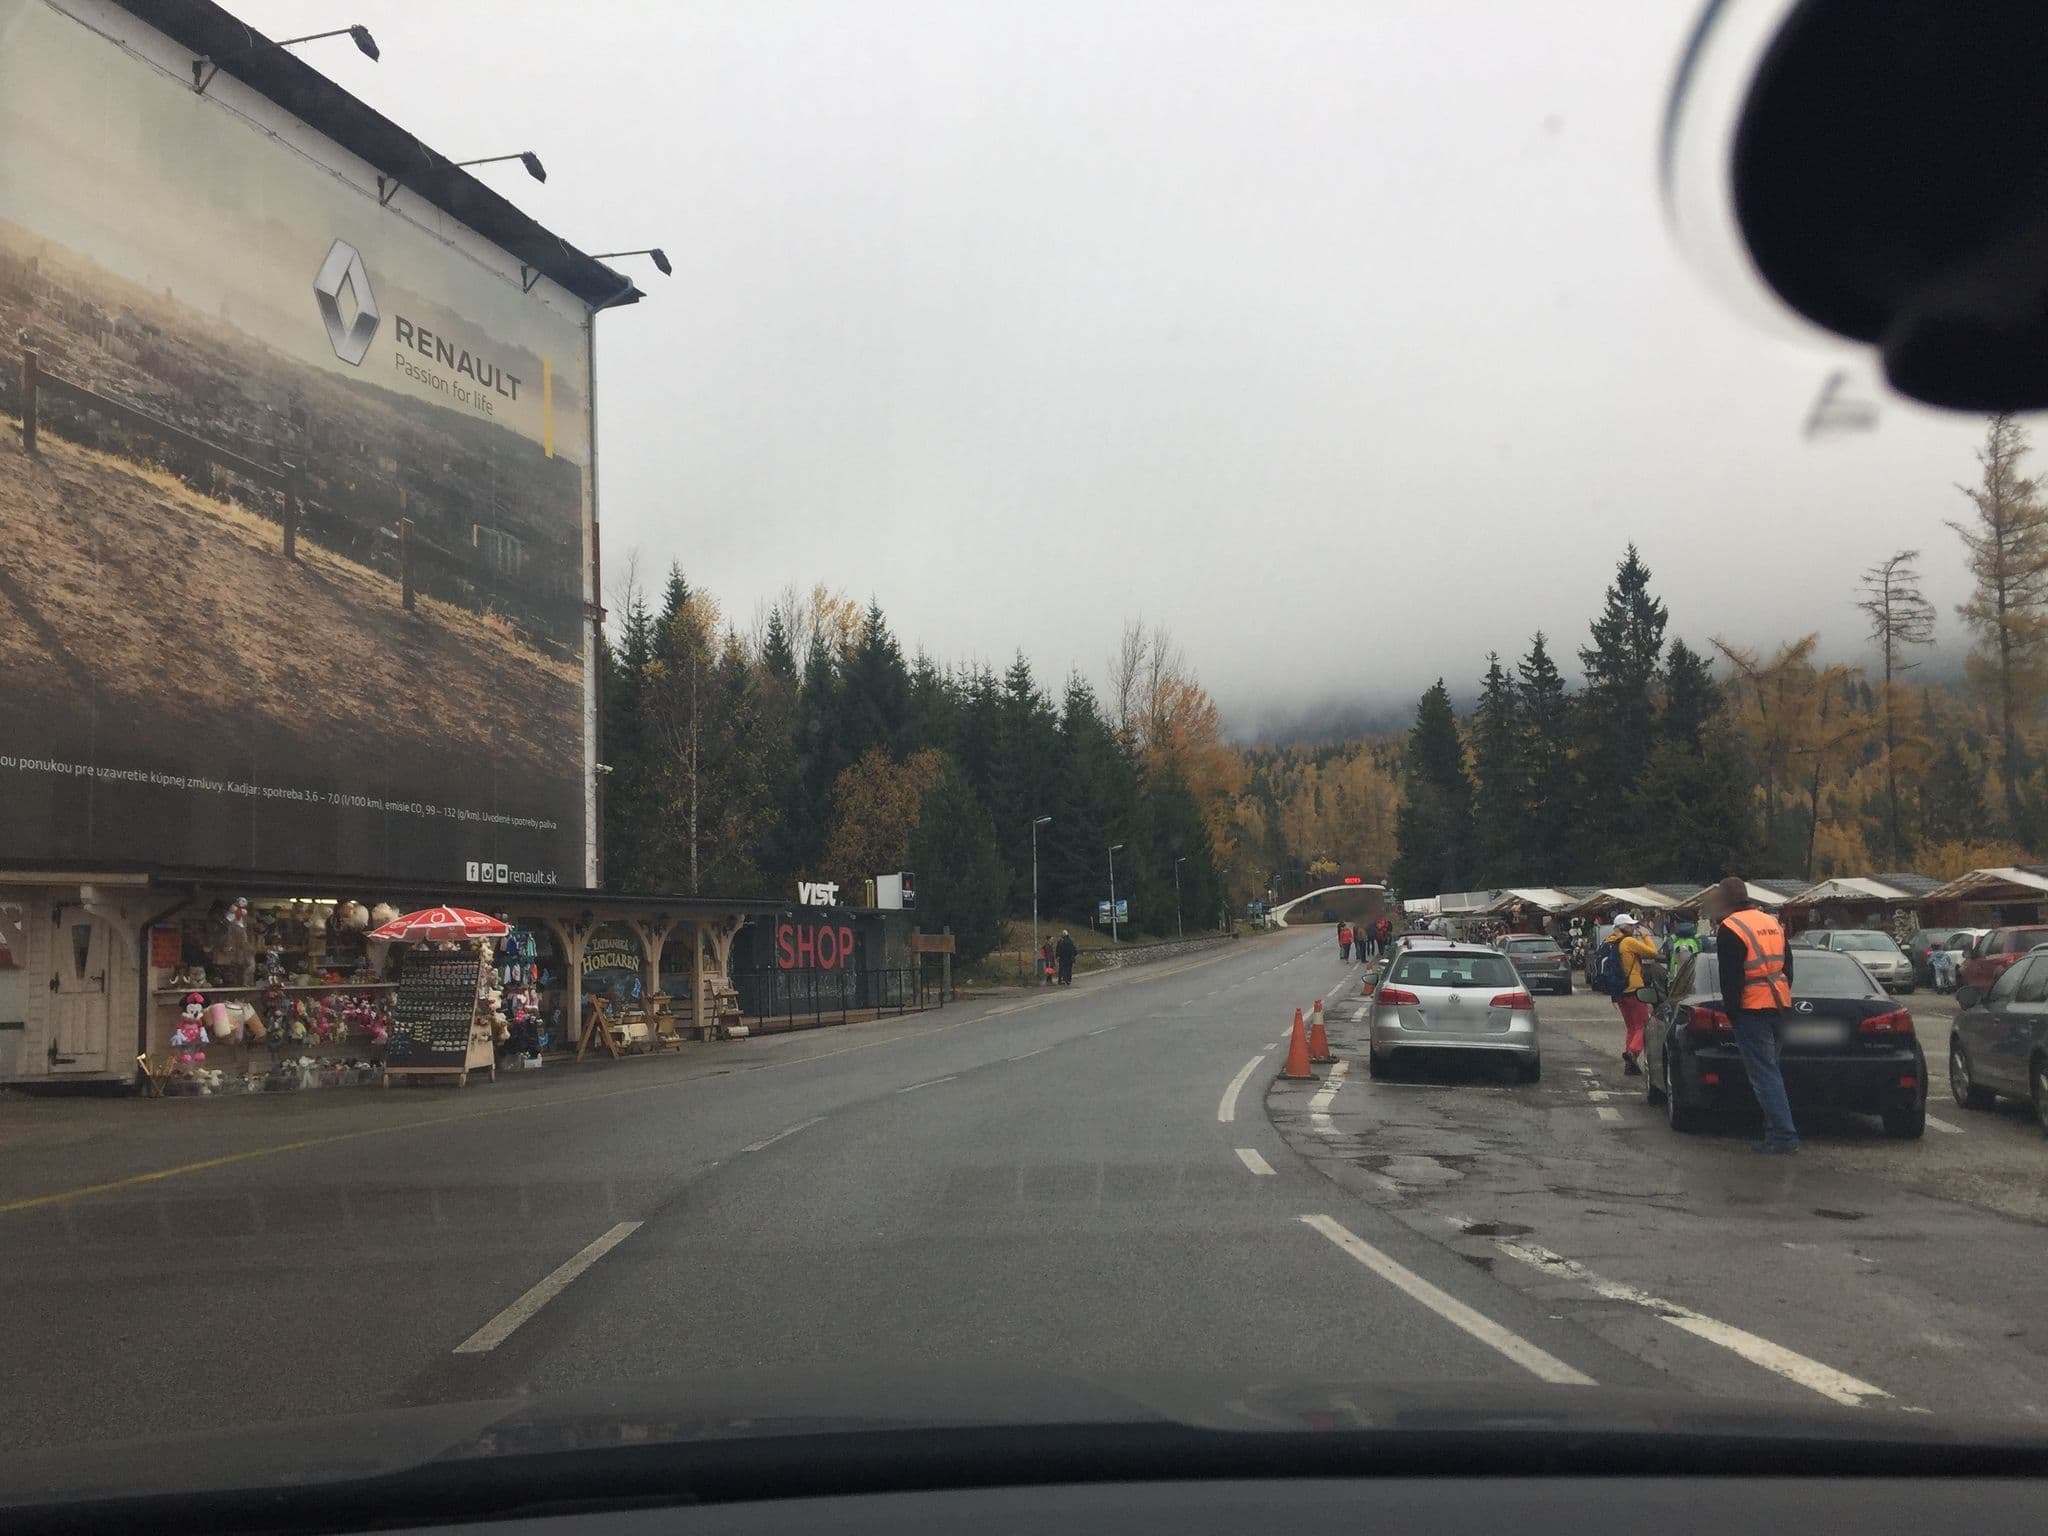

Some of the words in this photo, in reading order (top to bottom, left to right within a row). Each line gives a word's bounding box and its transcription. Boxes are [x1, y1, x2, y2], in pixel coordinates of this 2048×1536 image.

[395, 314, 522, 401] RENAULT
[395, 352, 449, 394] Passion
[452, 380, 471, 403] for
[474, 390, 494, 416] life
[19, 757, 73, 774] ponukou
[74, 764, 94, 777] pre
[96, 767, 148, 782] uzavretie
[150, 770, 185, 789] kúpnej
[227, 780, 261, 797] Kadjar:
[262, 785, 303, 801] spotreba
[305, 790, 319, 802] 3,6
[384, 801, 410, 813] emisie
[425, 805, 436, 816] 99
[443, 807, 456, 818] 132
[510, 869, 558, 885] renault.sk
[777, 923, 855, 970] SHOP
